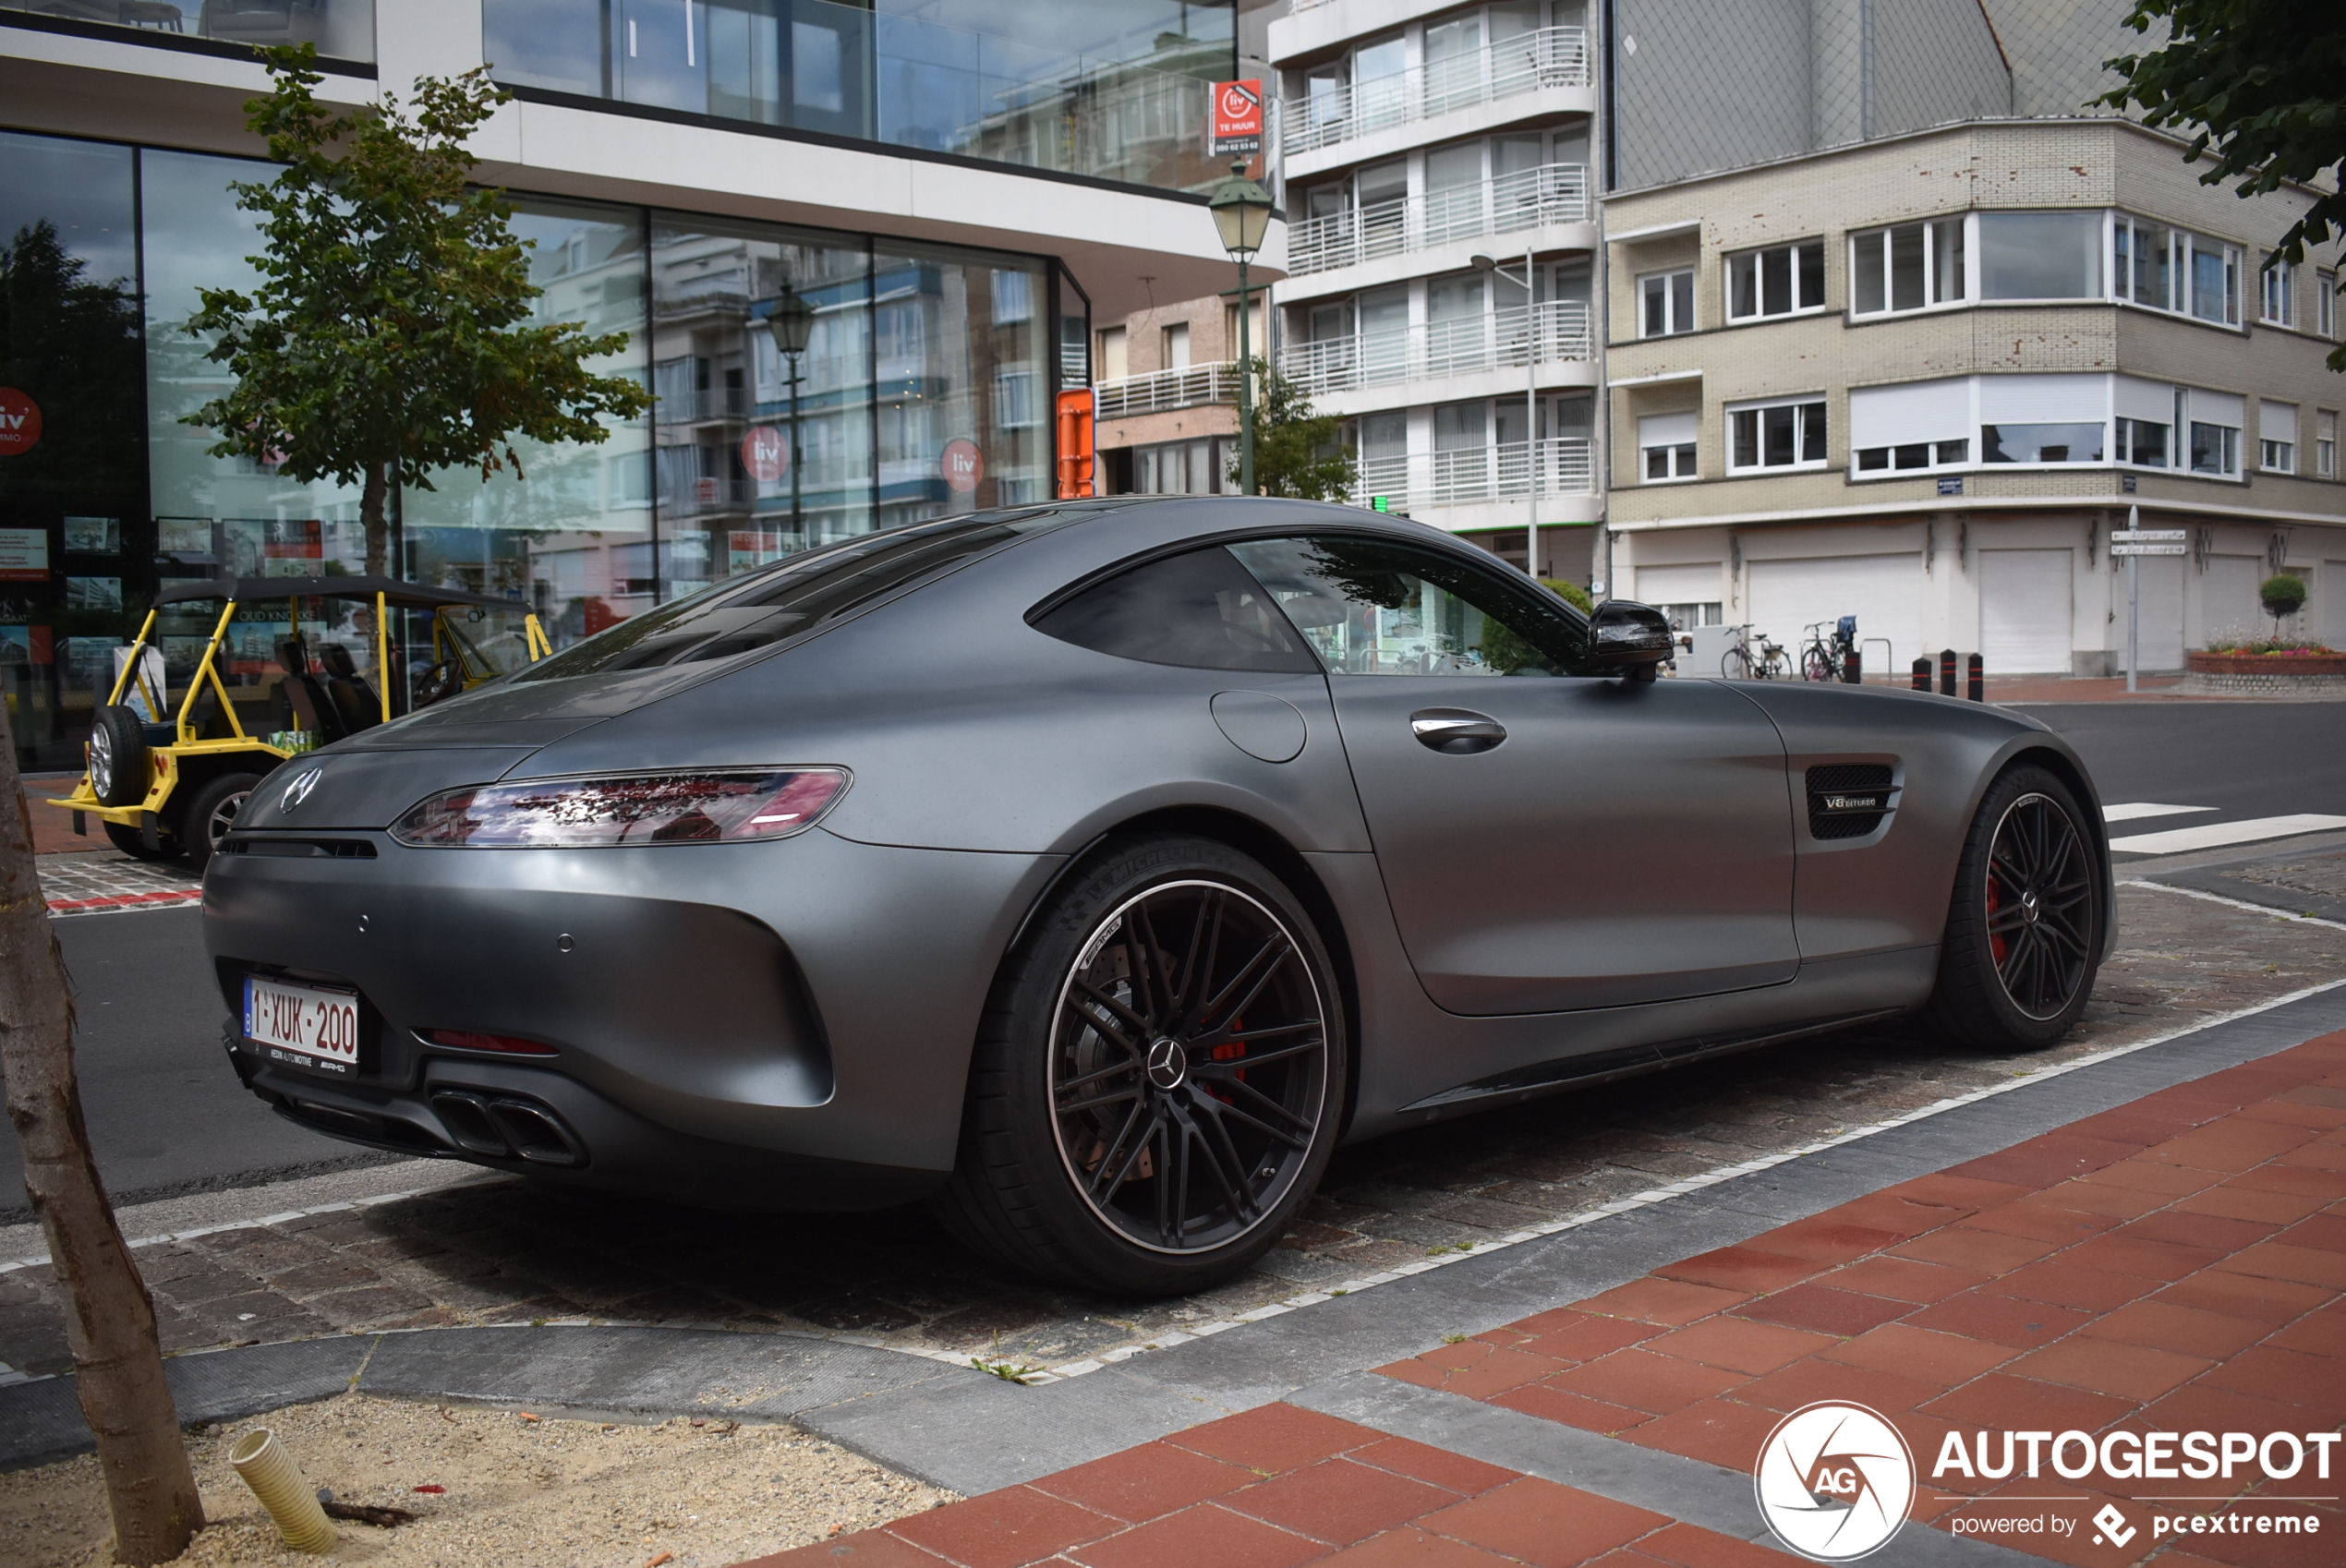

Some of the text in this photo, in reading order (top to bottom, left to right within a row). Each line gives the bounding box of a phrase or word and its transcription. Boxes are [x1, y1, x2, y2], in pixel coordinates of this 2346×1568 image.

[1220, 121, 1255, 131] TE HUUR
[238, 610, 266, 621] OUD
[1825, 798, 1876, 808] V8 BITURBO
[1092, 921, 1120, 958] AMG
[246, 1013, 251, 1033] B
[324, 1061, 345, 1072] AMG
